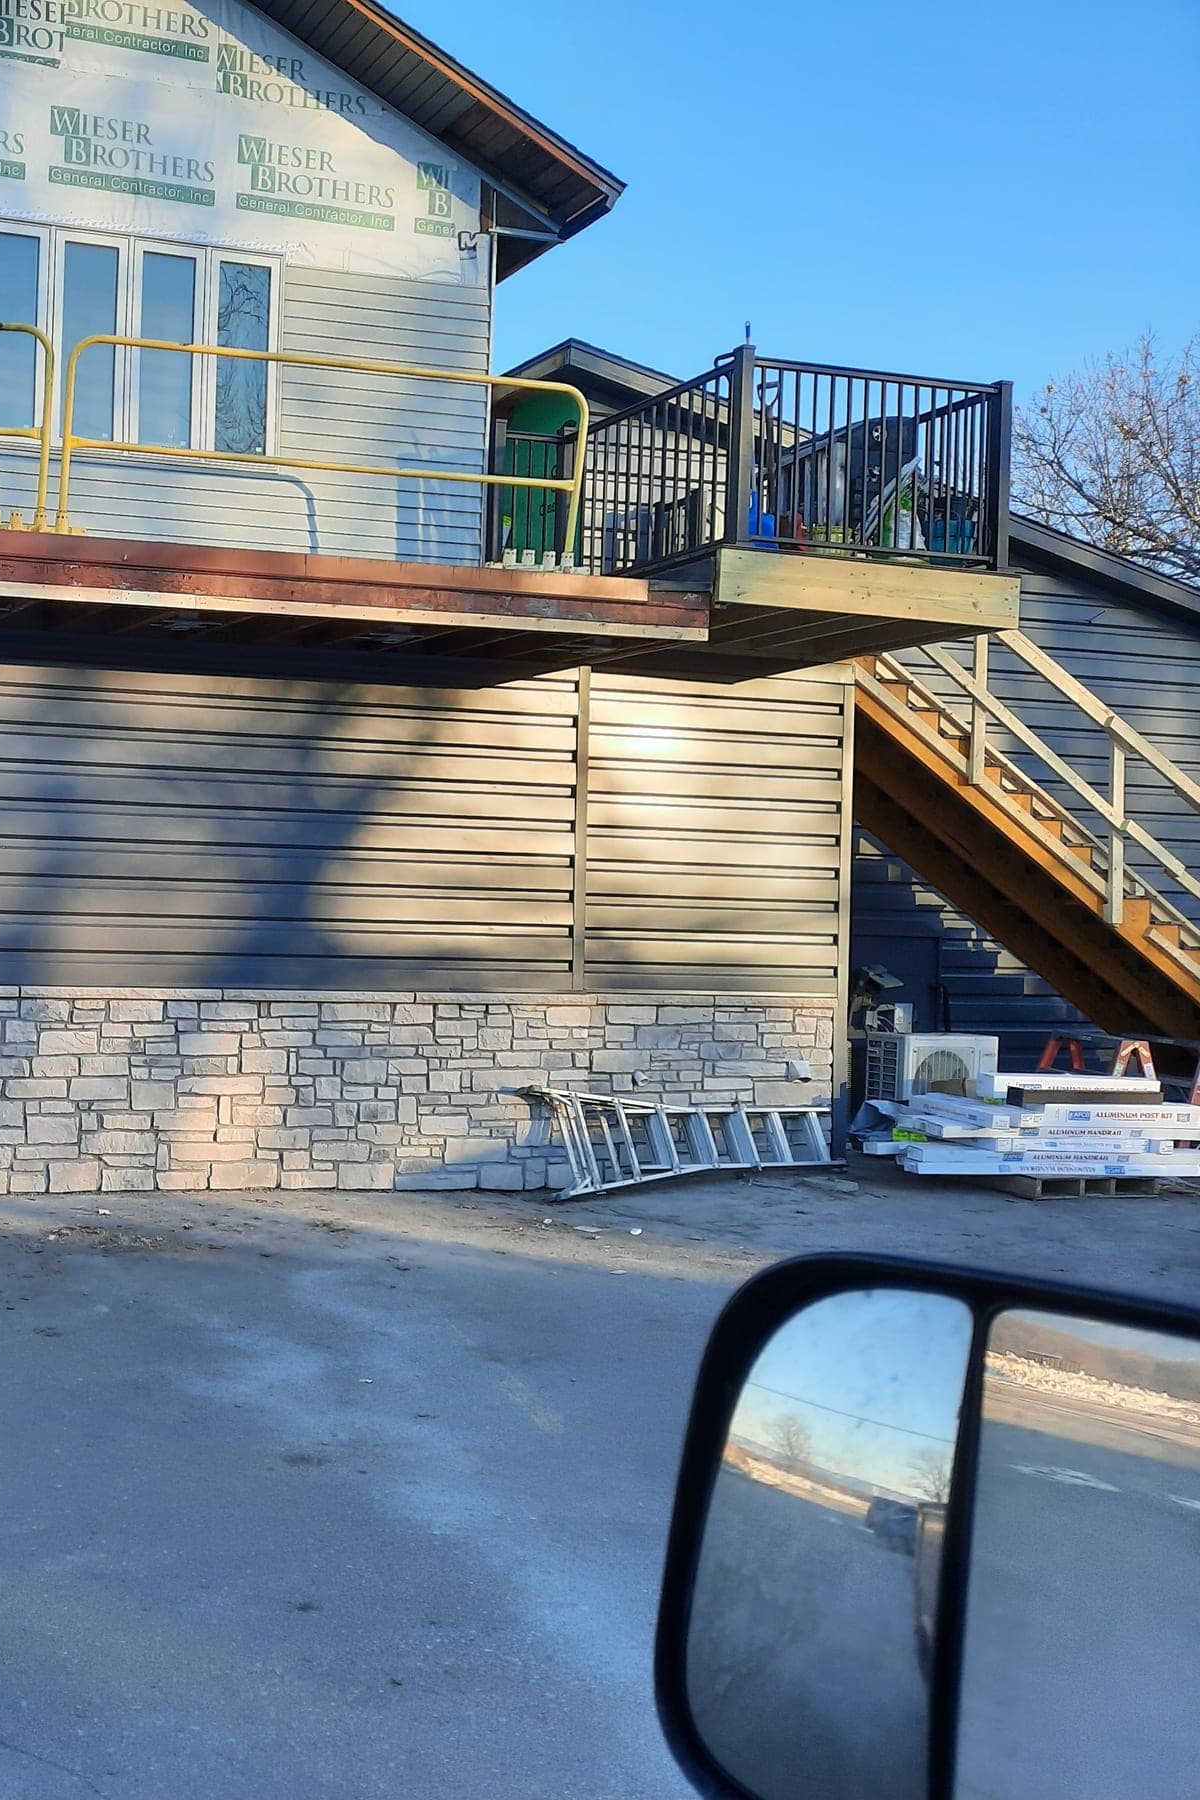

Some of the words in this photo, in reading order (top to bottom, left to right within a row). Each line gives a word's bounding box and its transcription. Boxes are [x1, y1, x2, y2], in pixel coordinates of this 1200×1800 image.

[52, 108, 153, 145] WIESER
[0, 162, 24, 177] Inc.
[70, 138, 215, 183] BROTHERS
[239, 136, 336, 172] WIESER
[51, 168, 106, 187] General
[111, 177, 185, 200] Contractor,
[190, 189, 214, 204] Inc.
[257, 165, 395, 208] BROTHERS
[238, 195, 290, 213] General
[294, 203, 367, 225] Contractor,
[371, 214, 394, 229] Inc.
[1095, 1111, 1138, 1119] ALUMINUM
